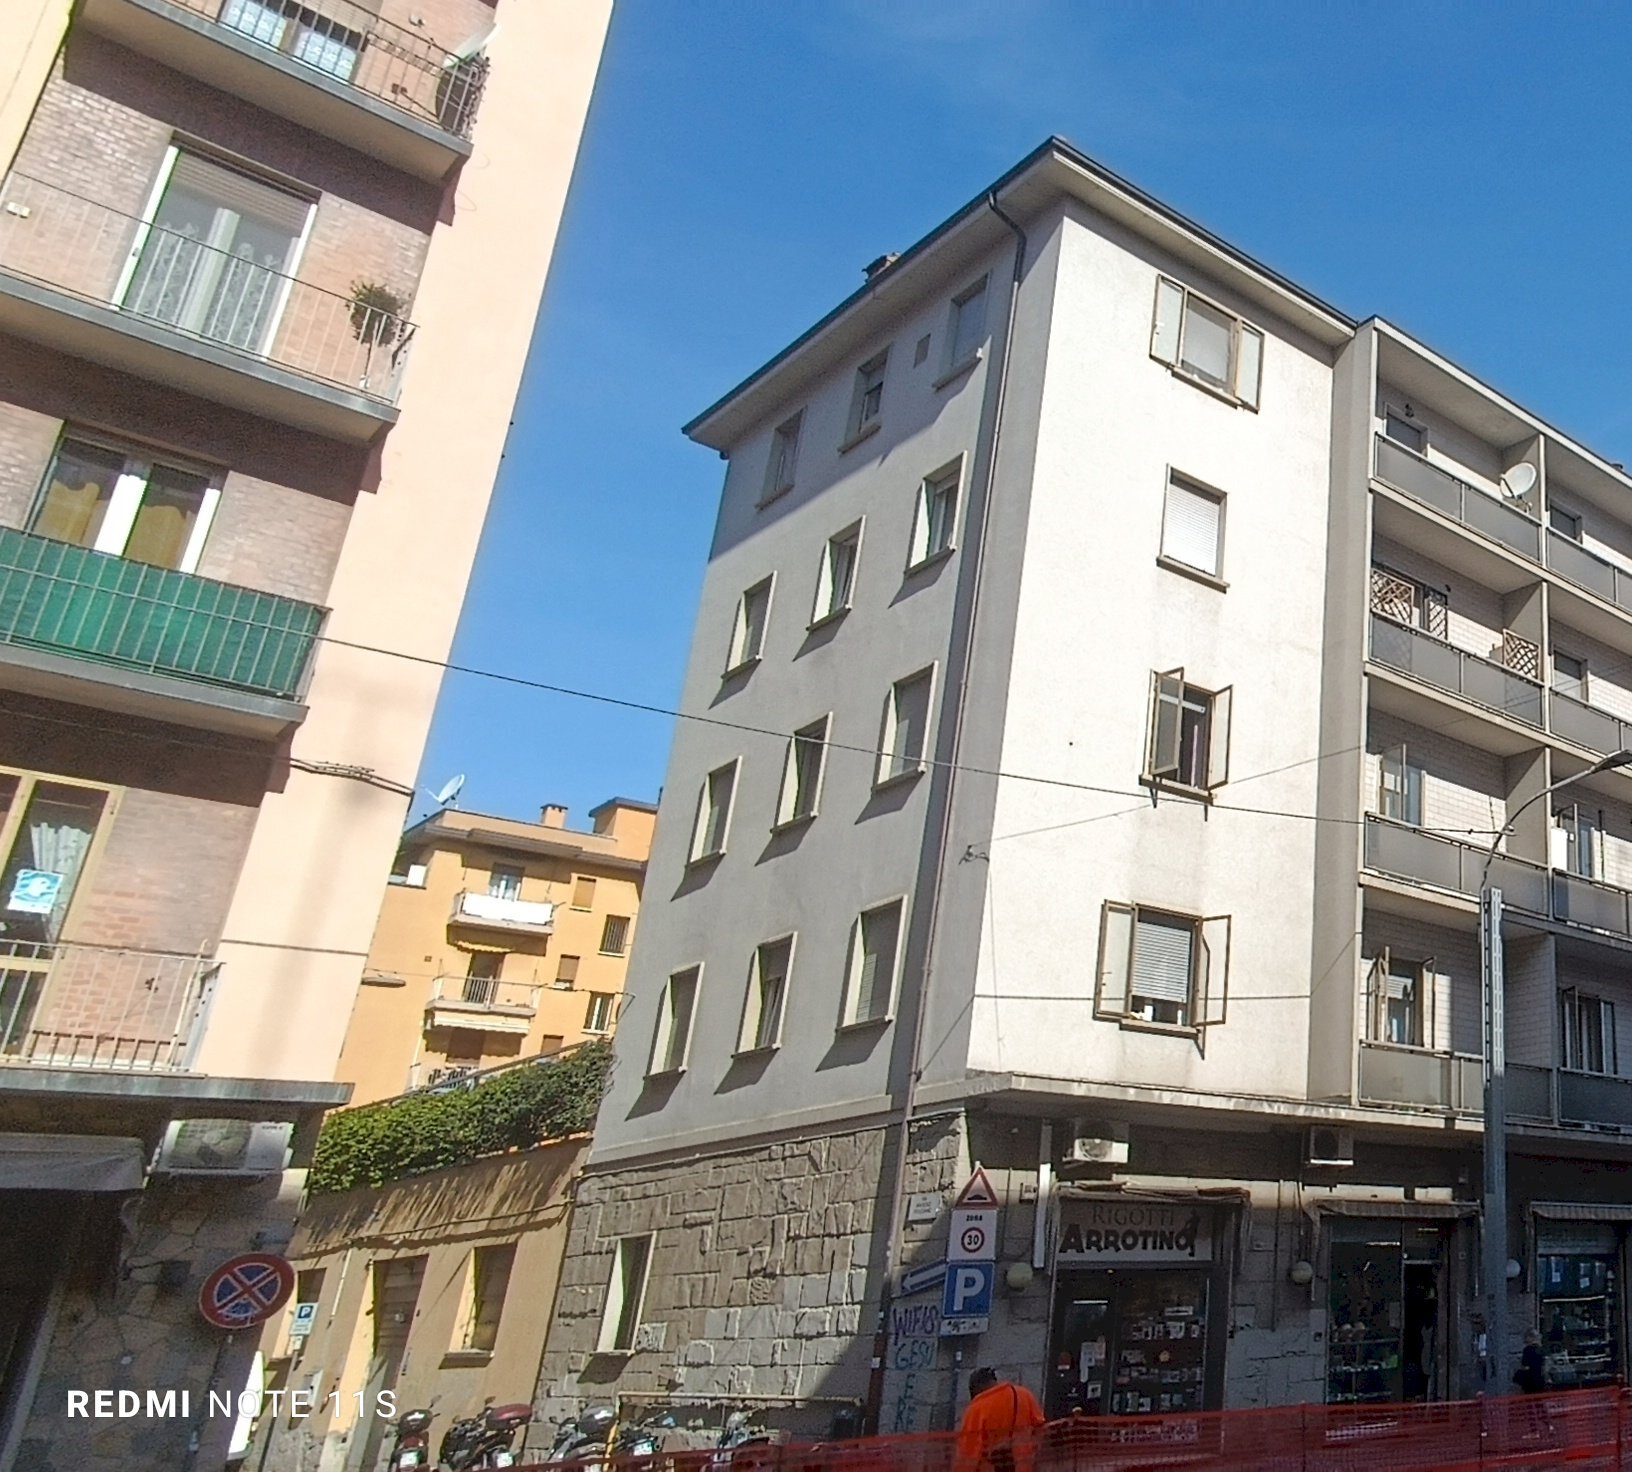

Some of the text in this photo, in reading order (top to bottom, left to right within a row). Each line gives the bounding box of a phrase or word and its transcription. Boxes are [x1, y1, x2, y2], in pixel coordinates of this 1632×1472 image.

[1092, 1204, 1174, 1226] RIGOTTI
[966, 1234, 980, 1246] 30
[1058, 1223, 1190, 1254] ARROTINO
[953, 1267, 985, 1312] P
[301, 1306, 311, 1317] P
